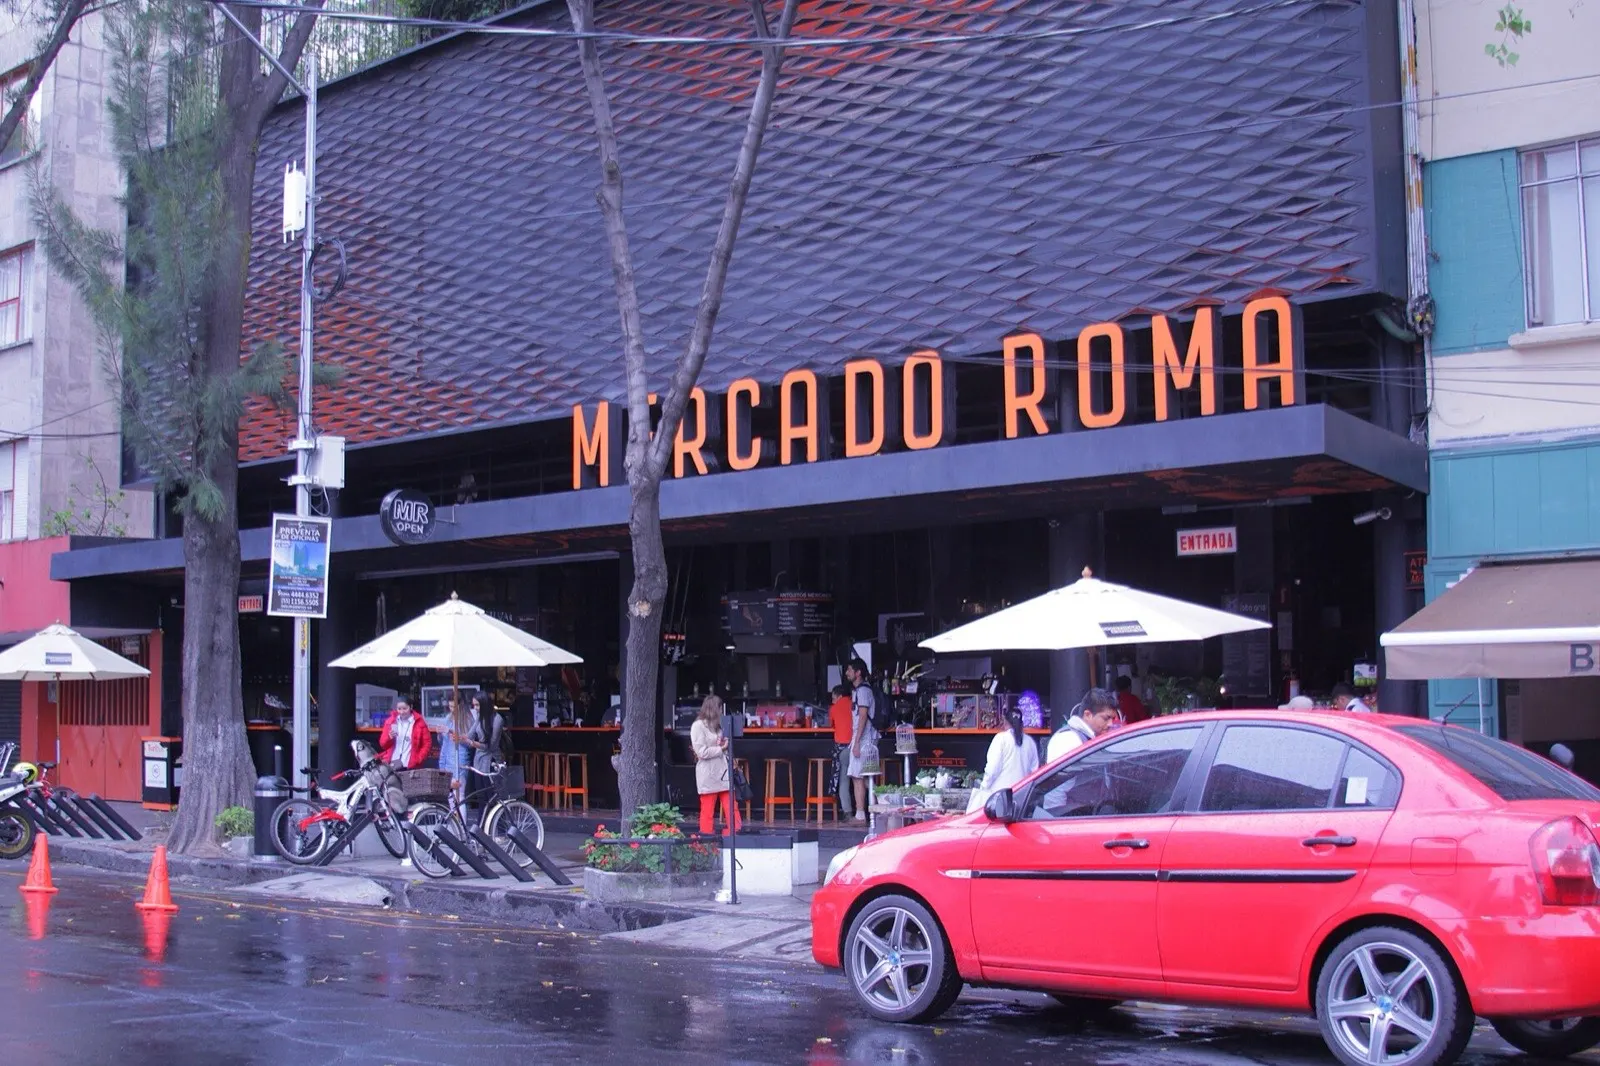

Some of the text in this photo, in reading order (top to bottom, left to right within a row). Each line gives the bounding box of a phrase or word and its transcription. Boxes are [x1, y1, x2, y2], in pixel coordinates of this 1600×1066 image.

[572, 296, 1295, 490] MRCADO ROMA
[393, 499, 429, 524] MR
[280, 527, 321, 537] PREVENTA
[396, 522, 424, 534] OPEN
[291, 534, 320, 543] OFICINAS
[1180, 532, 1233, 551] ENTRADA
[1570, 643, 1600, 672] B
